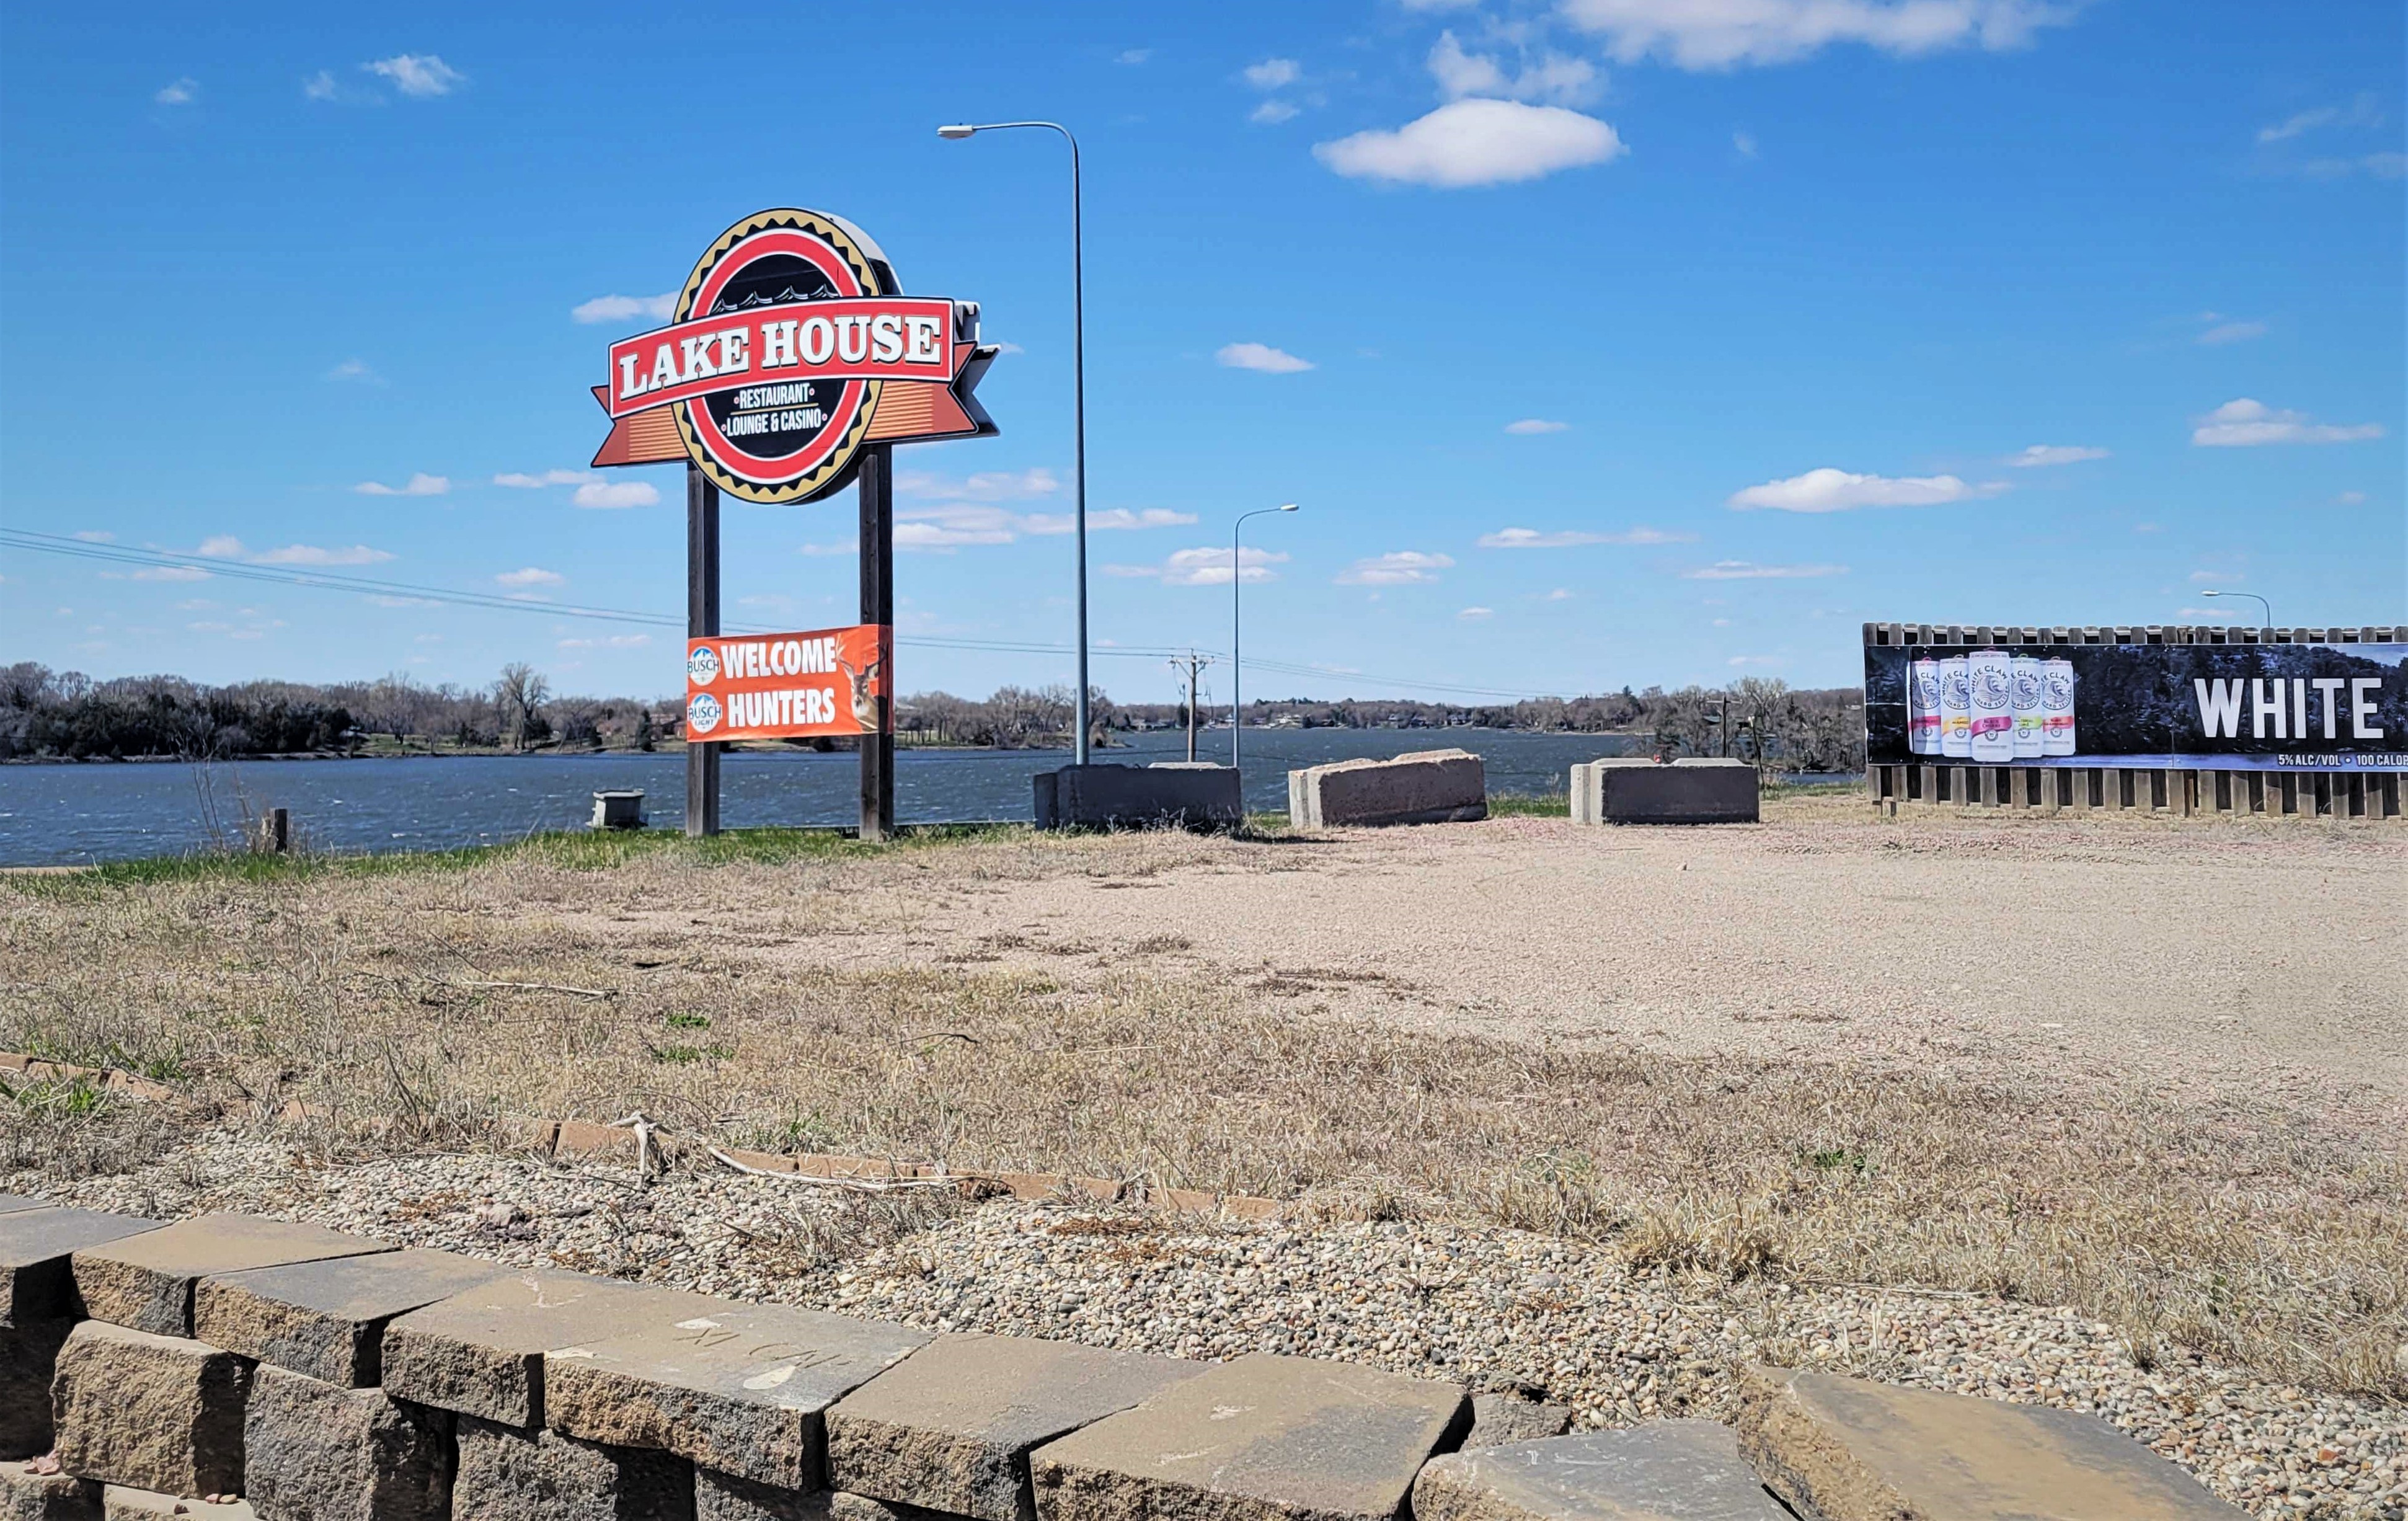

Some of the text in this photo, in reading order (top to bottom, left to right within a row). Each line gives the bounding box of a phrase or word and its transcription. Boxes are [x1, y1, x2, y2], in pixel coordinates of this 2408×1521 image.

[619, 314, 941, 400] LAKE HOUSE
[739, 382, 810, 409] RESTAURANT
[726, 408, 821, 437] LOUNGE & CASINO
[687, 659, 719, 674] BUSCH
[720, 637, 837, 680] WELCOME
[1954, 670, 1969, 680] CLA
[1971, 665, 2007, 694] WHITE CLAW
[2017, 670, 2038, 683] CLAW
[2050, 672, 2070, 684] CLAW
[688, 706, 721, 719] BUSCH
[727, 687, 836, 728] HUNTERS
[2193, 678, 2384, 739] WHITE
[2278, 754, 2294, 766] 5%
[2295, 754, 2342, 766] ALC/VOL
[2357, 755, 2375, 766] 100
